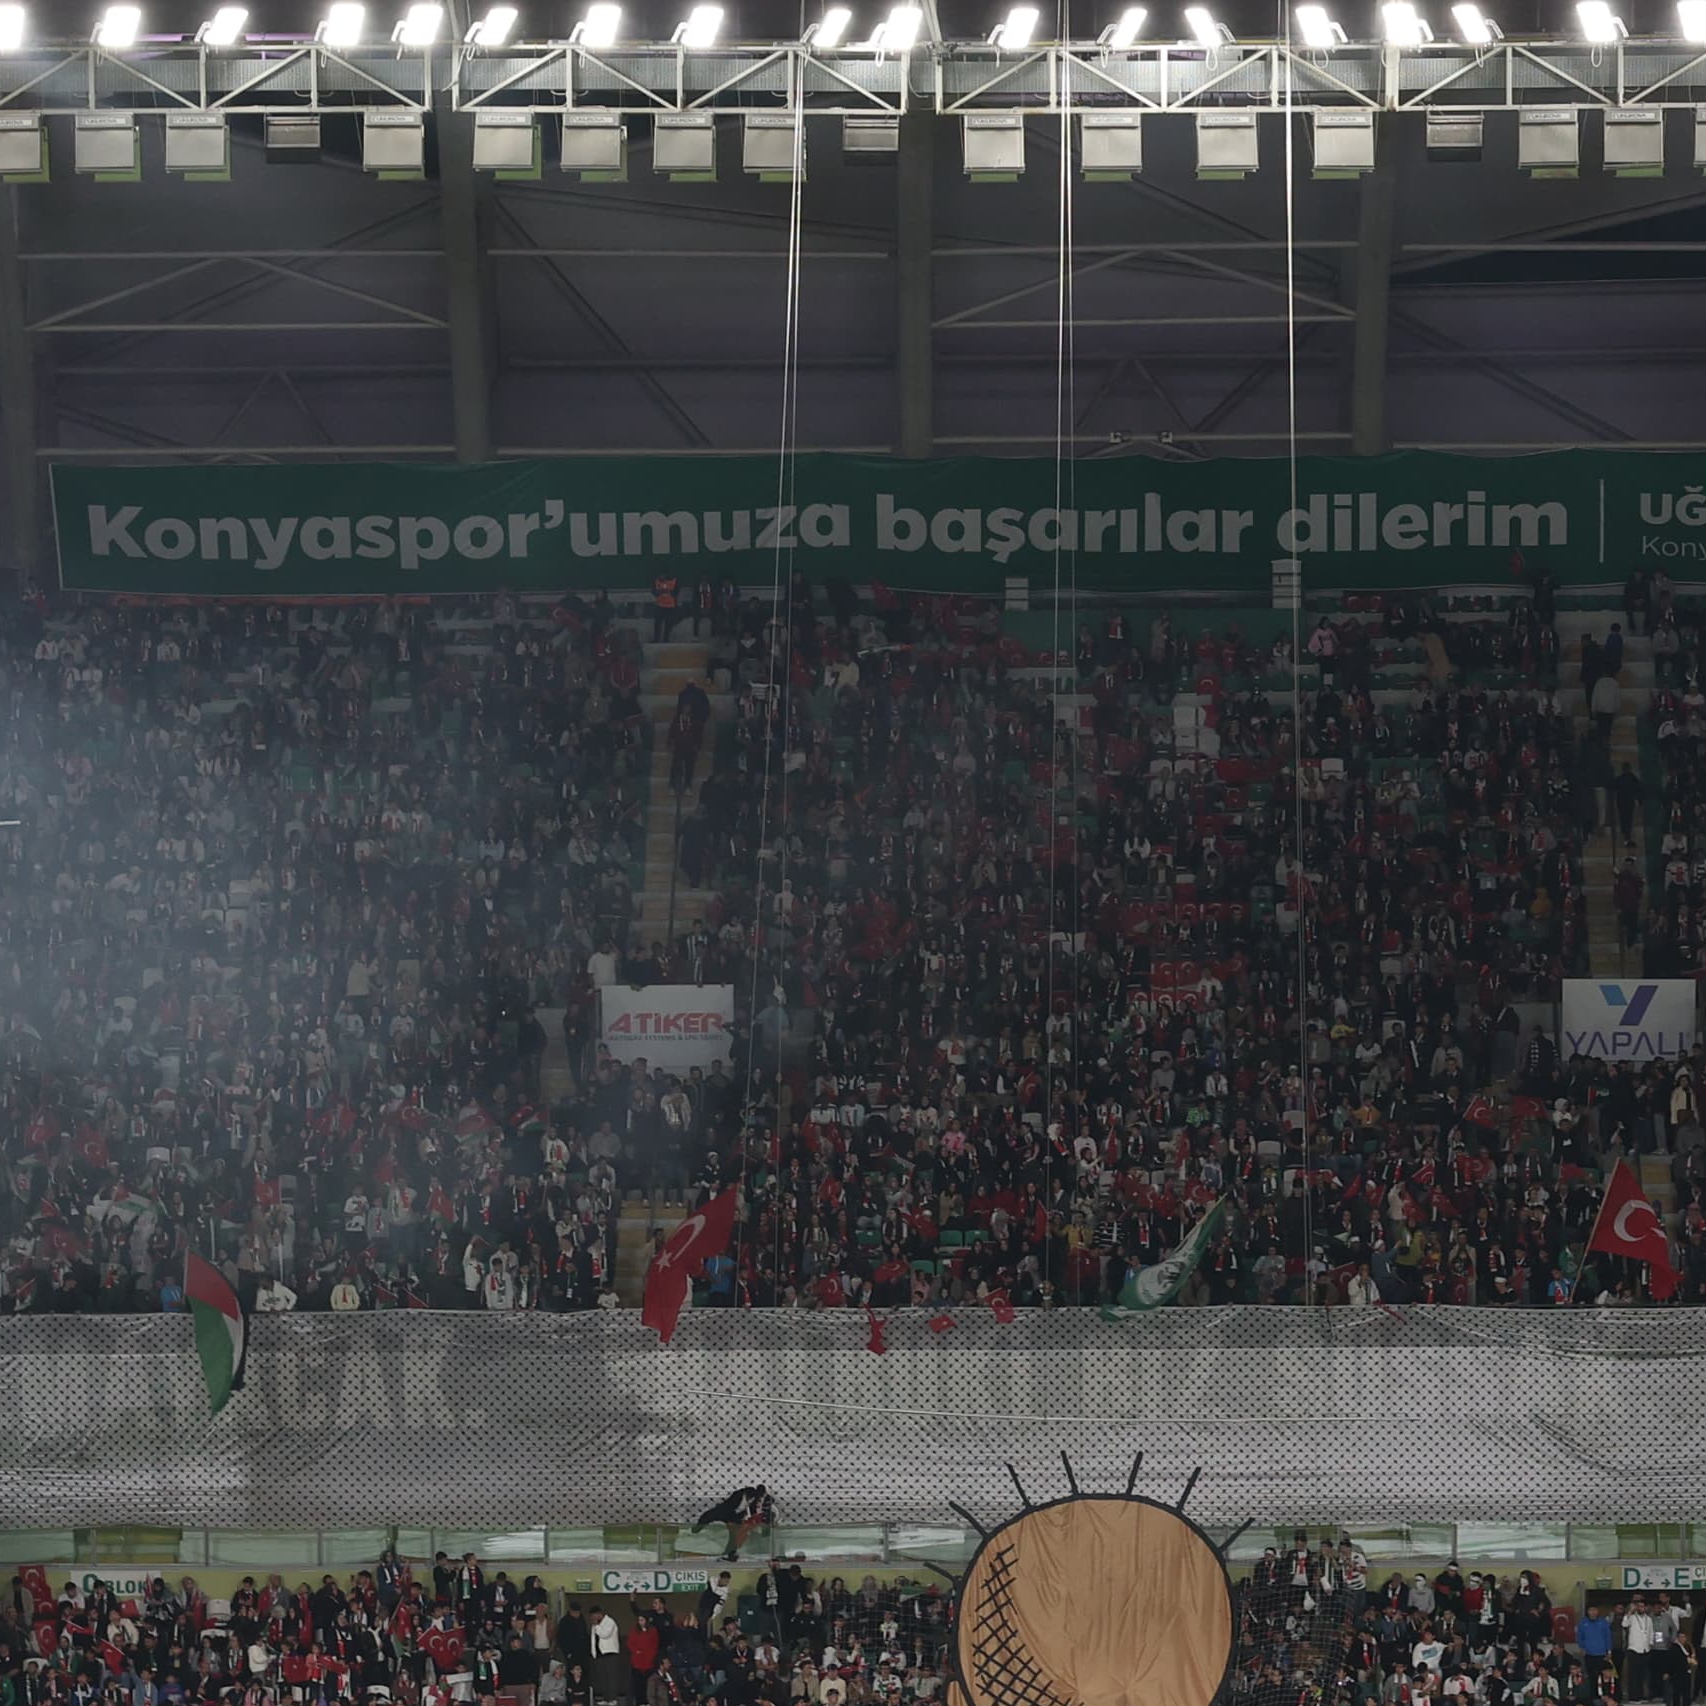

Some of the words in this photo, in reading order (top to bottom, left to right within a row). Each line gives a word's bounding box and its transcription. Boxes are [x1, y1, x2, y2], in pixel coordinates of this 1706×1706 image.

[875, 492, 1254, 565] başarılar
[1277, 488, 1568, 554] dilerim
[604, 1571, 621, 1591] C
[654, 1571, 671, 1590] D
[1624, 1567, 1642, 1589] D
[1675, 1567, 1691, 1589] E
